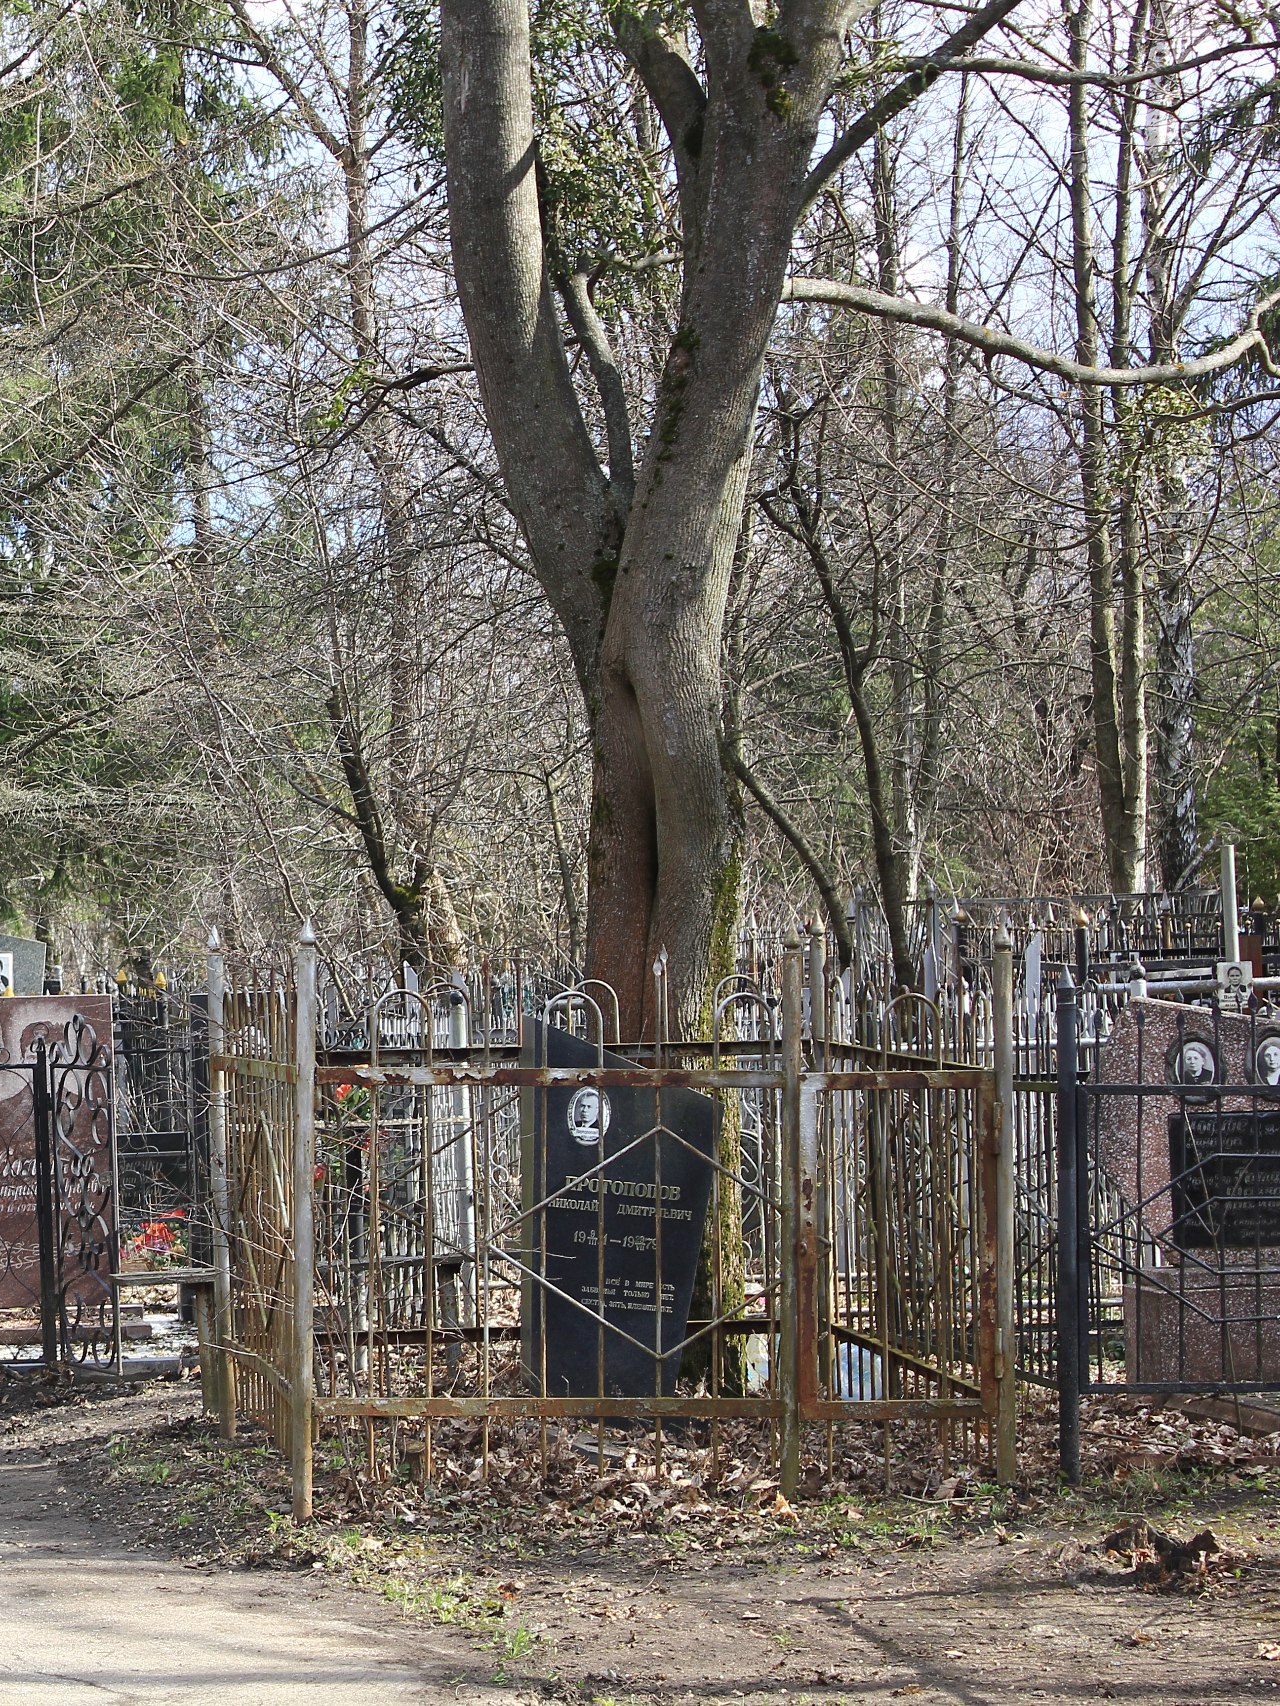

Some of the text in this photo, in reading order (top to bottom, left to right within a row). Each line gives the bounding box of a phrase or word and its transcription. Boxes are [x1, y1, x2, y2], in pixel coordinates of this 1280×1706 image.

[565, 1175, 681, 1201] ПРОТОПОПОВ
[616, 1203, 693, 1221] ДМИТРЕВИЧ
[635, 1281, 655, 1289] МИРЕ
[660, 1283, 676, 1291] СТЬ
[623, 1289, 650, 1299] ТОЛЬКО
